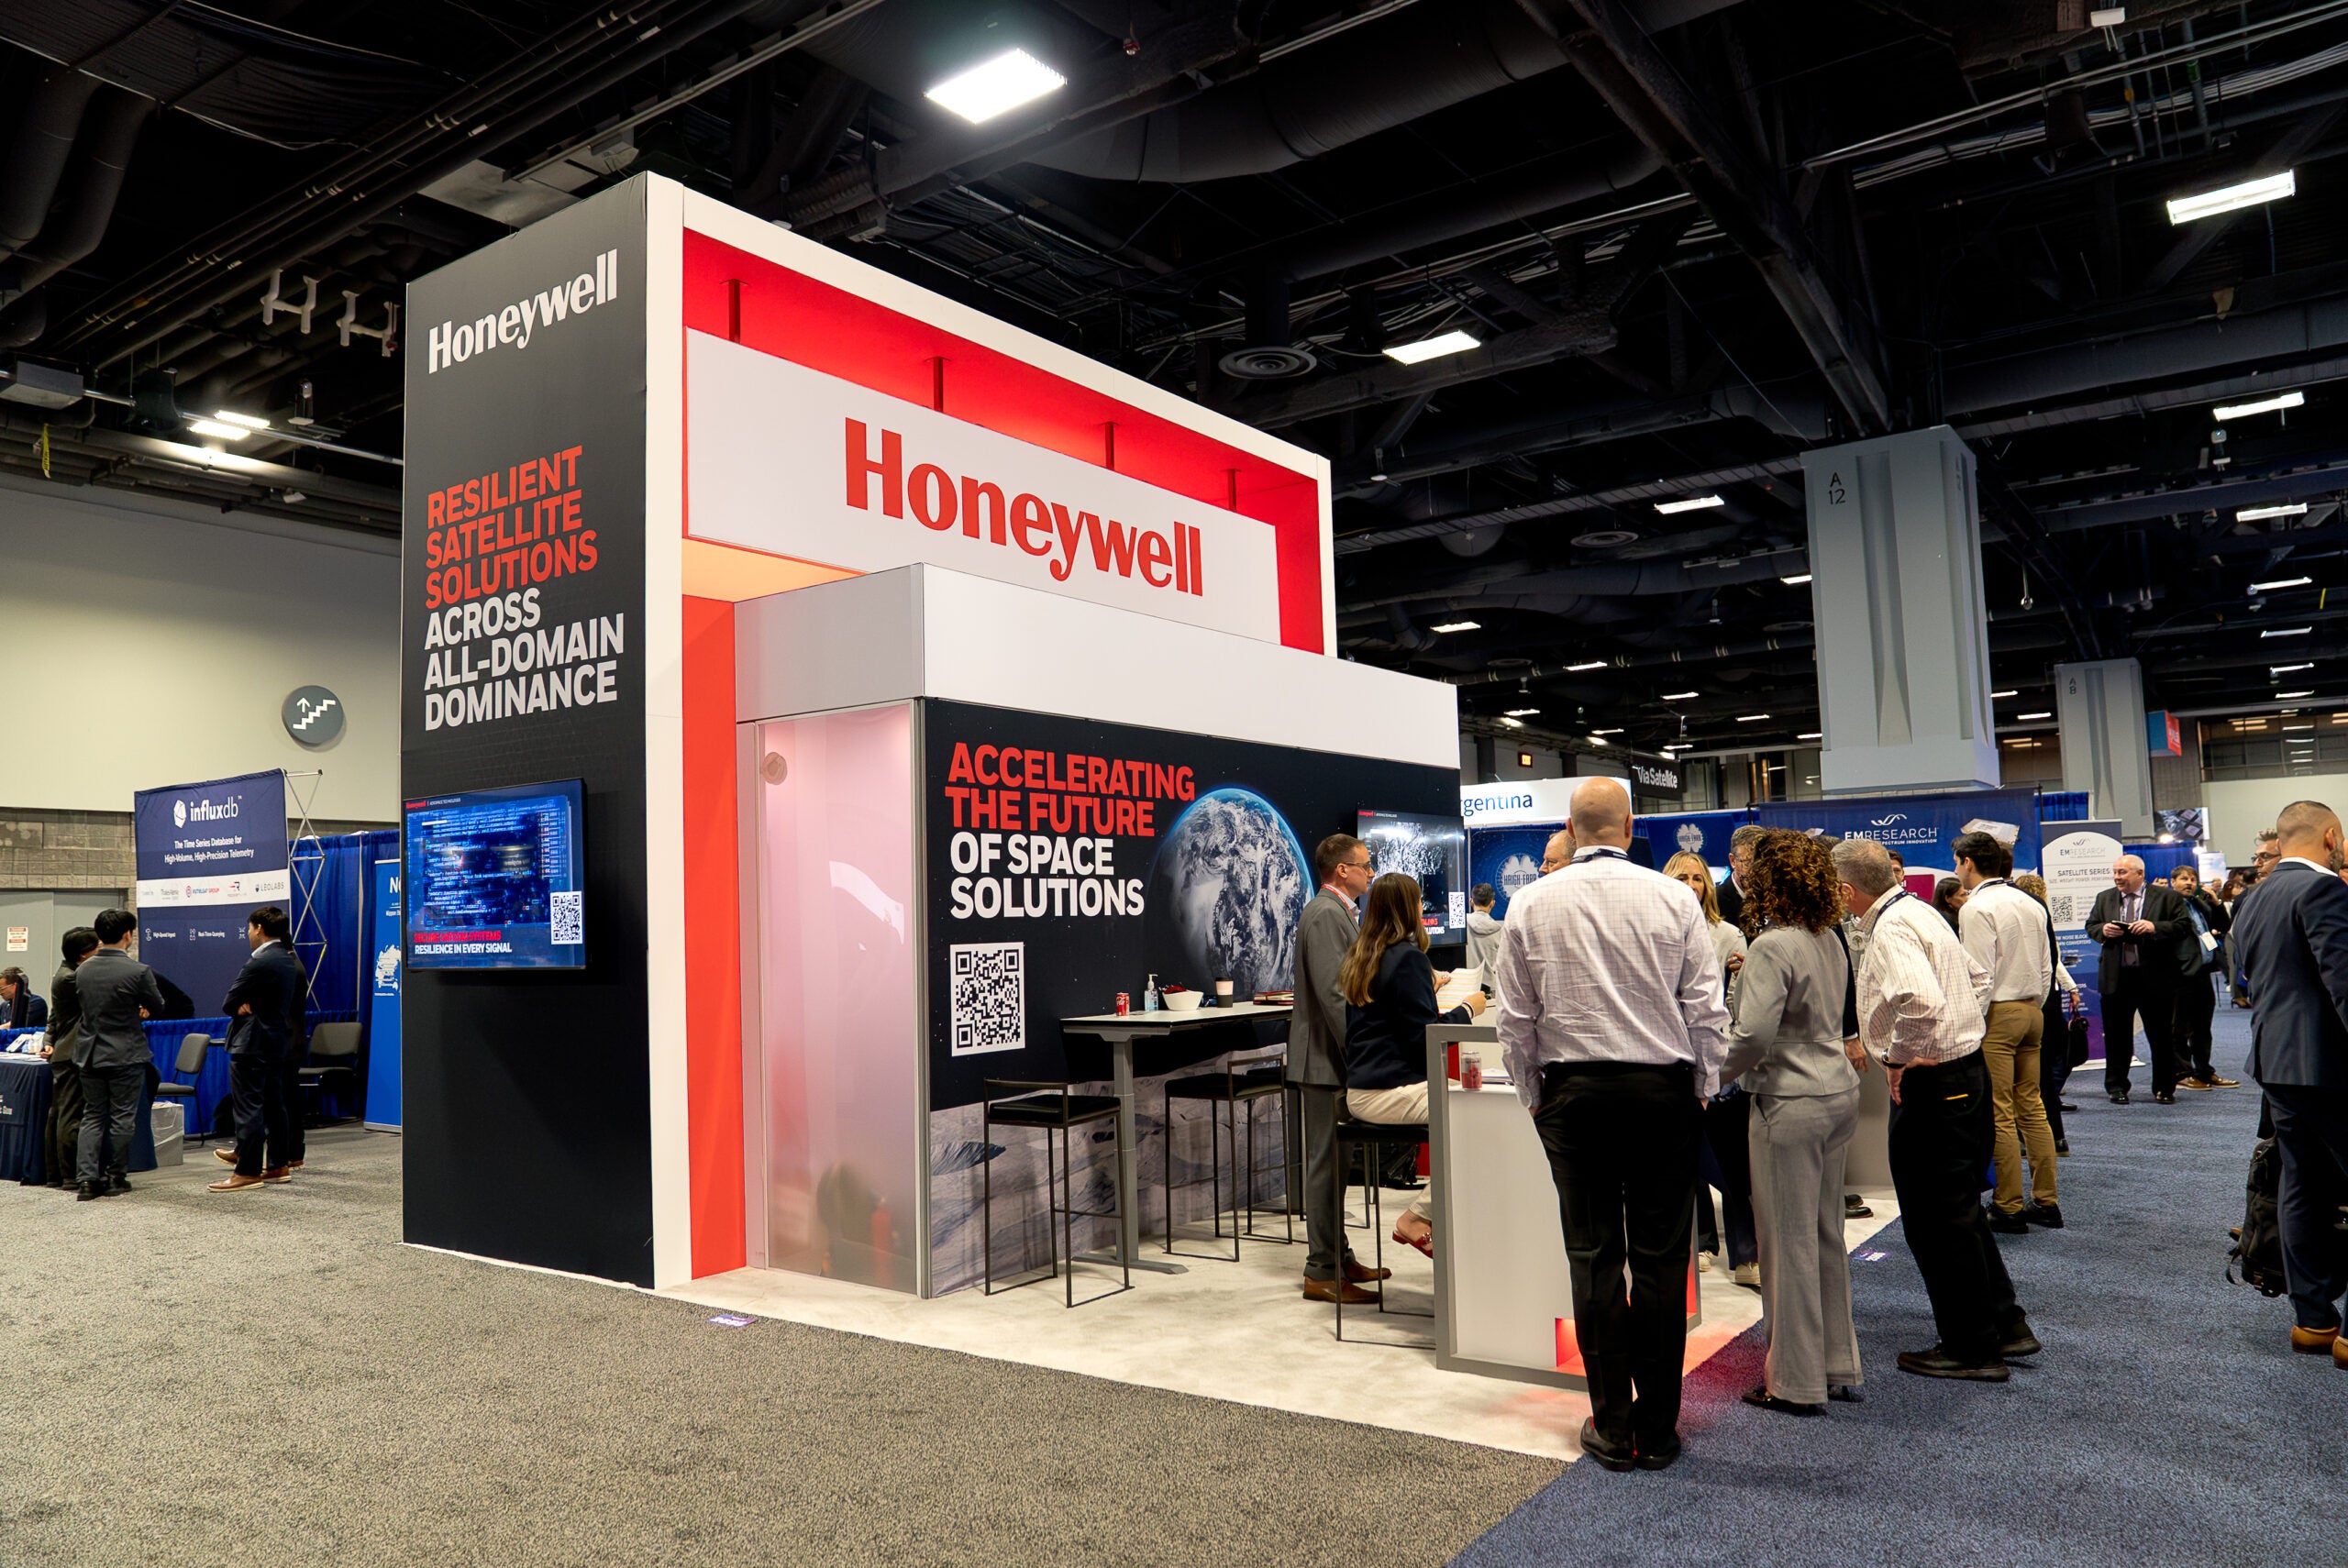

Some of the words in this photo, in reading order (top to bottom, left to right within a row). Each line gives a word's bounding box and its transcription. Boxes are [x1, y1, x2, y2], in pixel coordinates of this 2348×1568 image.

[428, 248, 617, 374] Honeywell
[427, 446, 582, 529] RESILIENT
[1828, 488, 1846, 505] 12
[1830, 472, 1843, 488] A
[846, 416, 1203, 597] Honeywell
[426, 489, 582, 569] SATELLITE
[425, 530, 598, 610] SOLUTIONS
[424, 587, 541, 650] ACROSS
[423, 612, 625, 691] ALL-DOMAIN
[425, 659, 618, 731] DOMINANCE
[947, 742, 1195, 801] ACCELERATING
[190, 796, 238, 823] influxdb
[945, 786, 1023, 831] THE
[1028, 793, 1156, 837] FUTURE
[1461, 794, 1534, 817] gentina
[174, 840, 183, 849] The
[183, 839, 195, 848] Time
[195, 838, 210, 847] Series
[211, 836, 234, 846] Database
[234, 835, 242, 845] for
[194, 850, 229, 863] High-Precision
[229, 848, 255, 859] Telemetry
[950, 833, 1002, 874] OF
[1007, 834, 1114, 877] SPACE
[1844, 827, 1937, 840] EMRESEARCH
[2057, 868, 2088, 877] SATELLITE
[950, 876, 1145, 920] SOLUTIONS
[415, 943, 454, 955] RESILIENCE
[453, 943, 462, 954] IN
[461, 943, 485, 954] EVERY
[485, 942, 513, 954] SIGNAL
